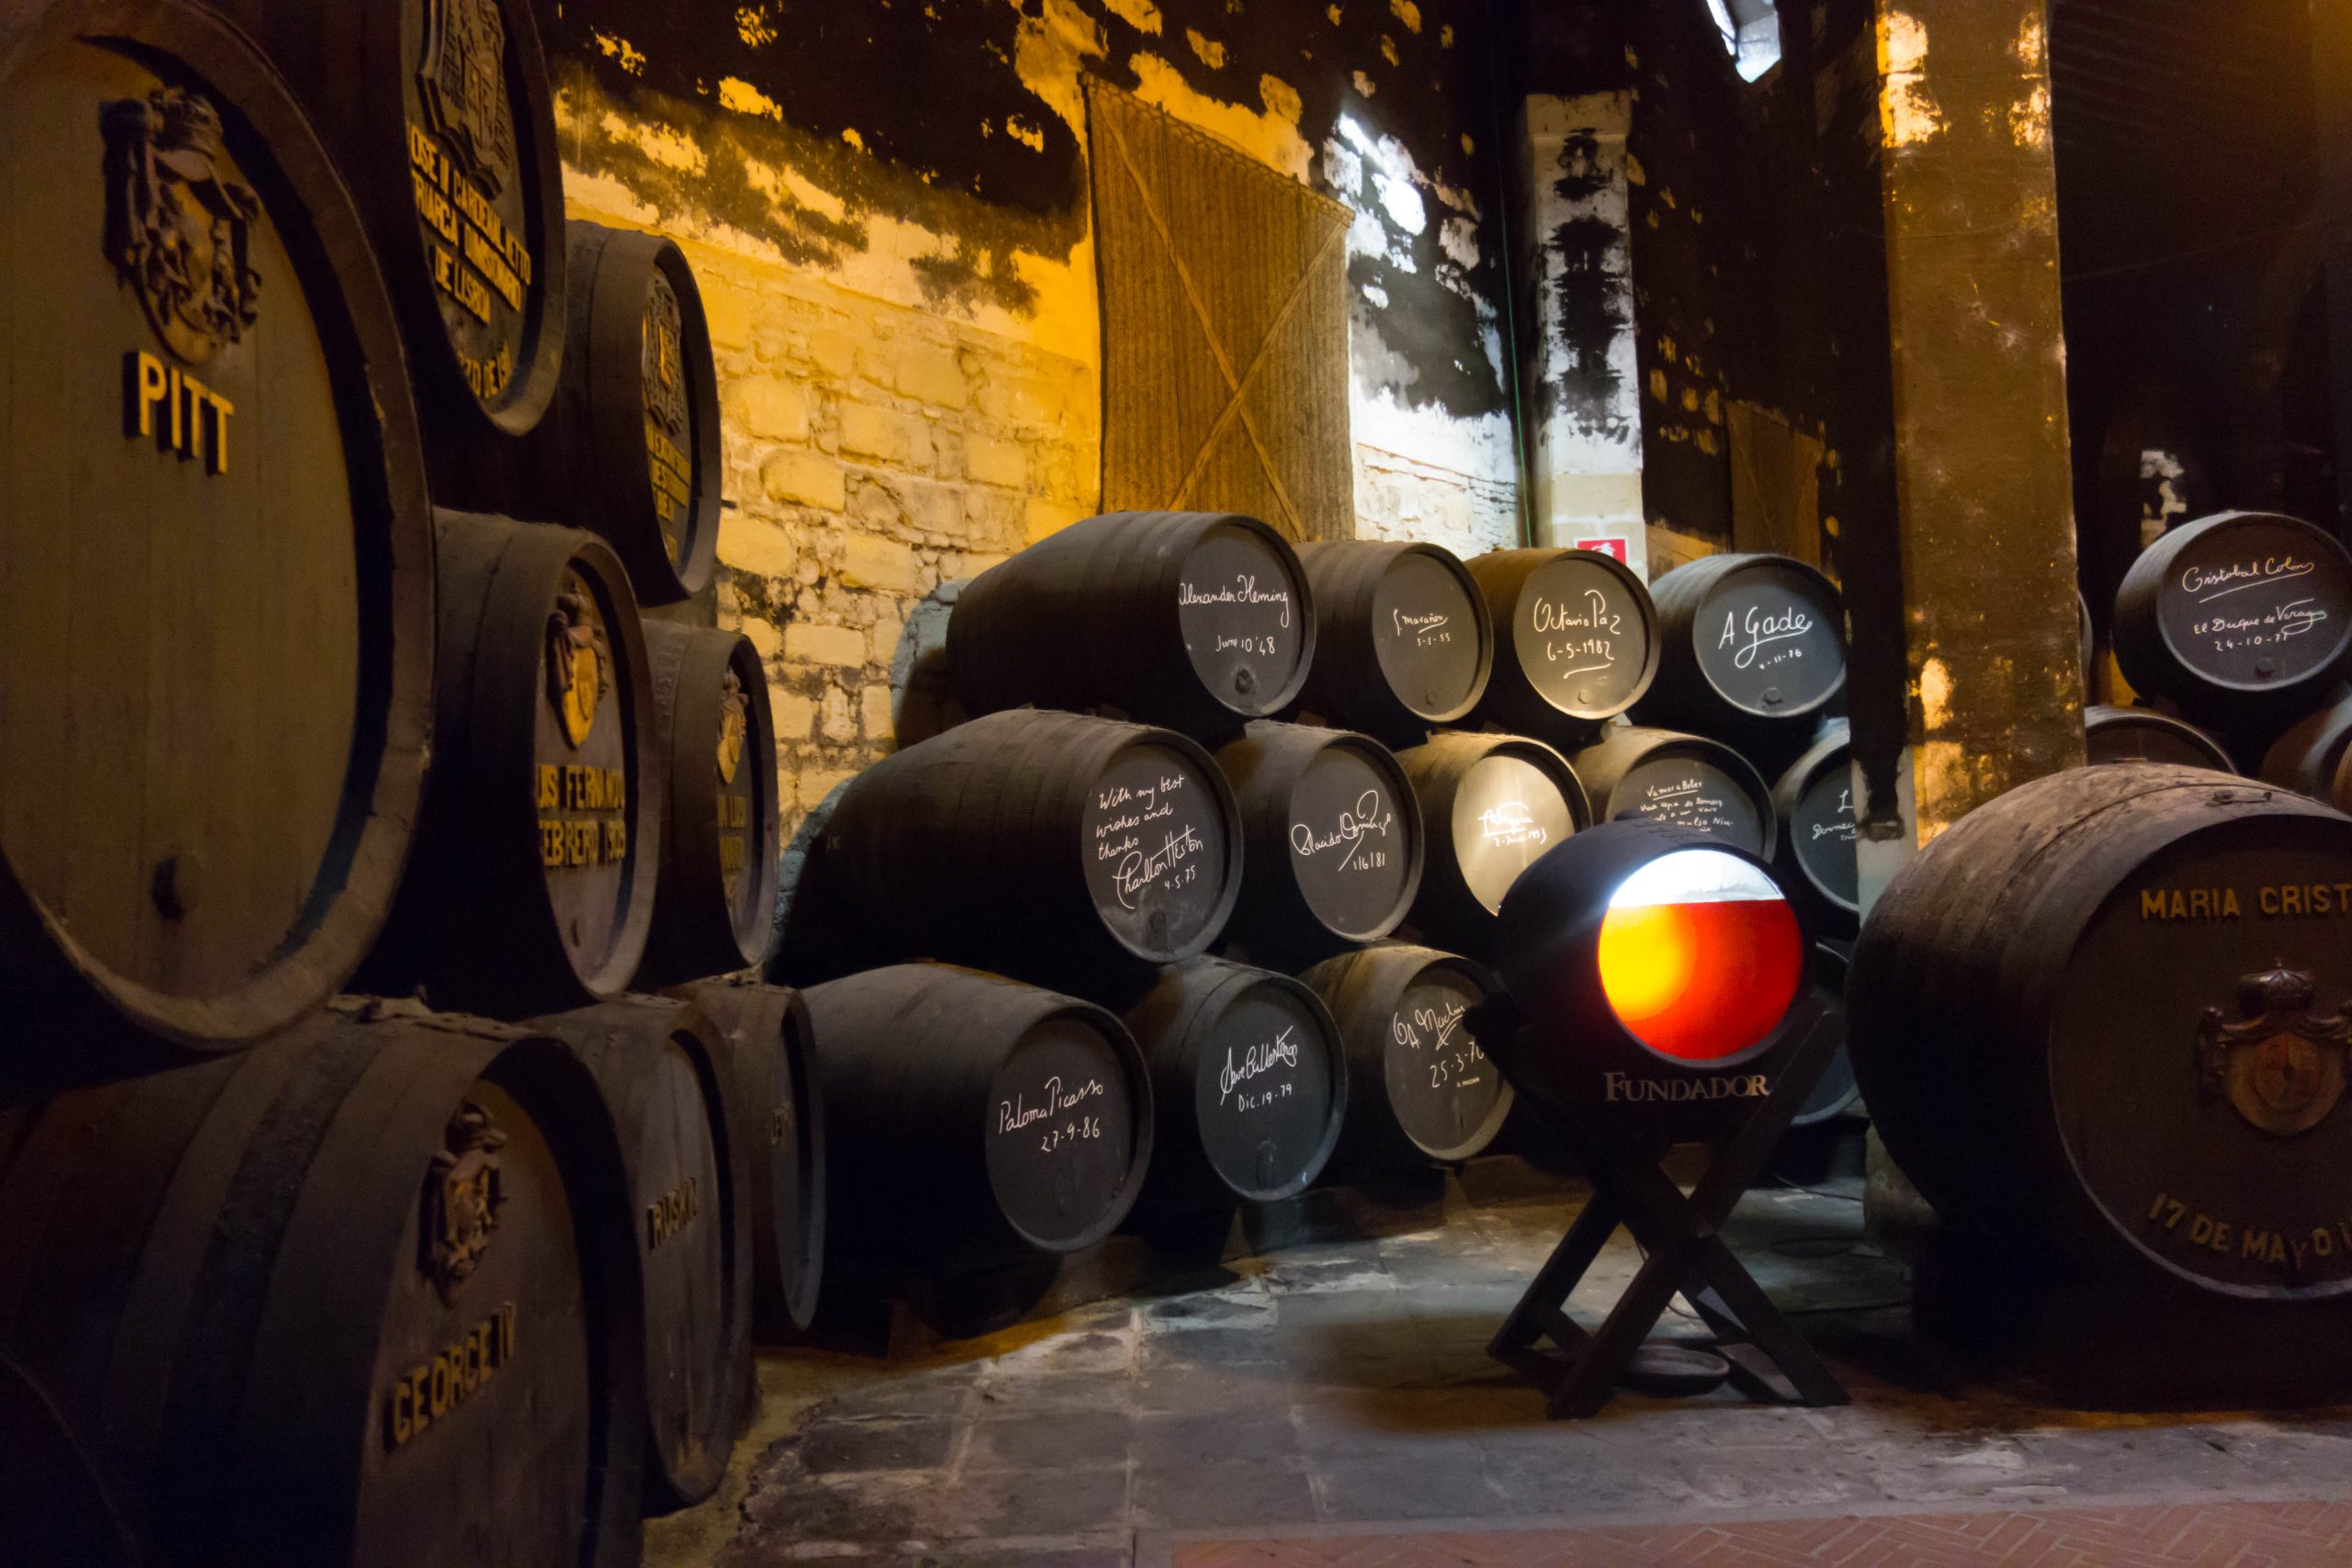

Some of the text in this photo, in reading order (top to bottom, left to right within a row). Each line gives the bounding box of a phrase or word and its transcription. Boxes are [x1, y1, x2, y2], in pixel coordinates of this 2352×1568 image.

[137, 350, 234, 475] PITT
[1584, 590, 1621, 635] Paz
[1718, 611, 1735, 649] A
[1099, 773, 1185, 810] With my best
[1095, 802, 1173, 839] wishes and
[1097, 835, 1138, 861] thanks
[2141, 887, 2241, 919] MARIA
[999, 1076, 1103, 1134] Paloma Picasso
[2148, 1191, 2188, 1230] 17
[2190, 1214, 2231, 1252] DE
[2241, 1226, 2332, 1270] MAYO
[393, 1321, 493, 1445] GEORGE
